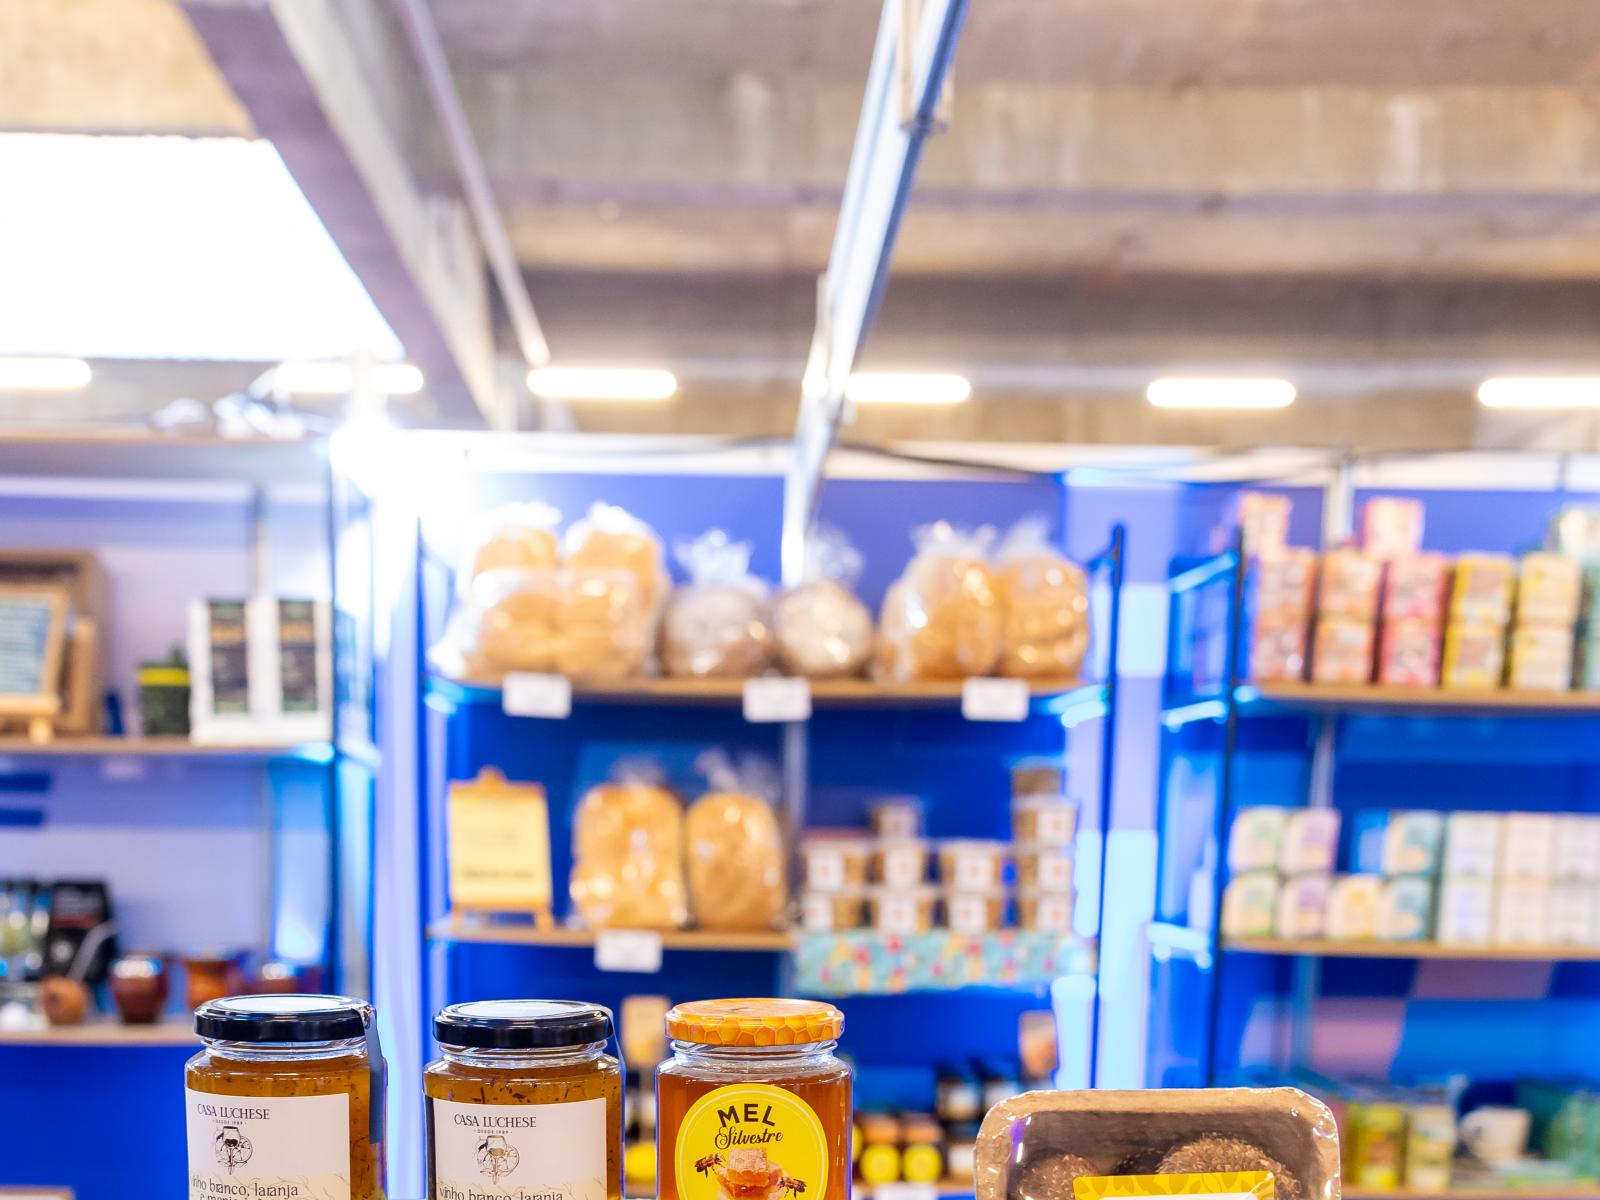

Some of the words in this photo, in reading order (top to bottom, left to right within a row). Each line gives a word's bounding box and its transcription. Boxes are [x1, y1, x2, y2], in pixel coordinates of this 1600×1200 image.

[197, 1103, 217, 1117] CASA
[220, 1106, 271, 1120] LUCHESE
[454, 1113, 480, 1127] CASA
[483, 1116, 537, 1128] LUCHESE
[717, 1103, 776, 1128] MEL
[714, 1126, 784, 1150] Silvestre
[192, 1174, 207, 1191] inho
[209, 1178, 250, 1197] branco,
[254, 1182, 299, 1200] laranja
